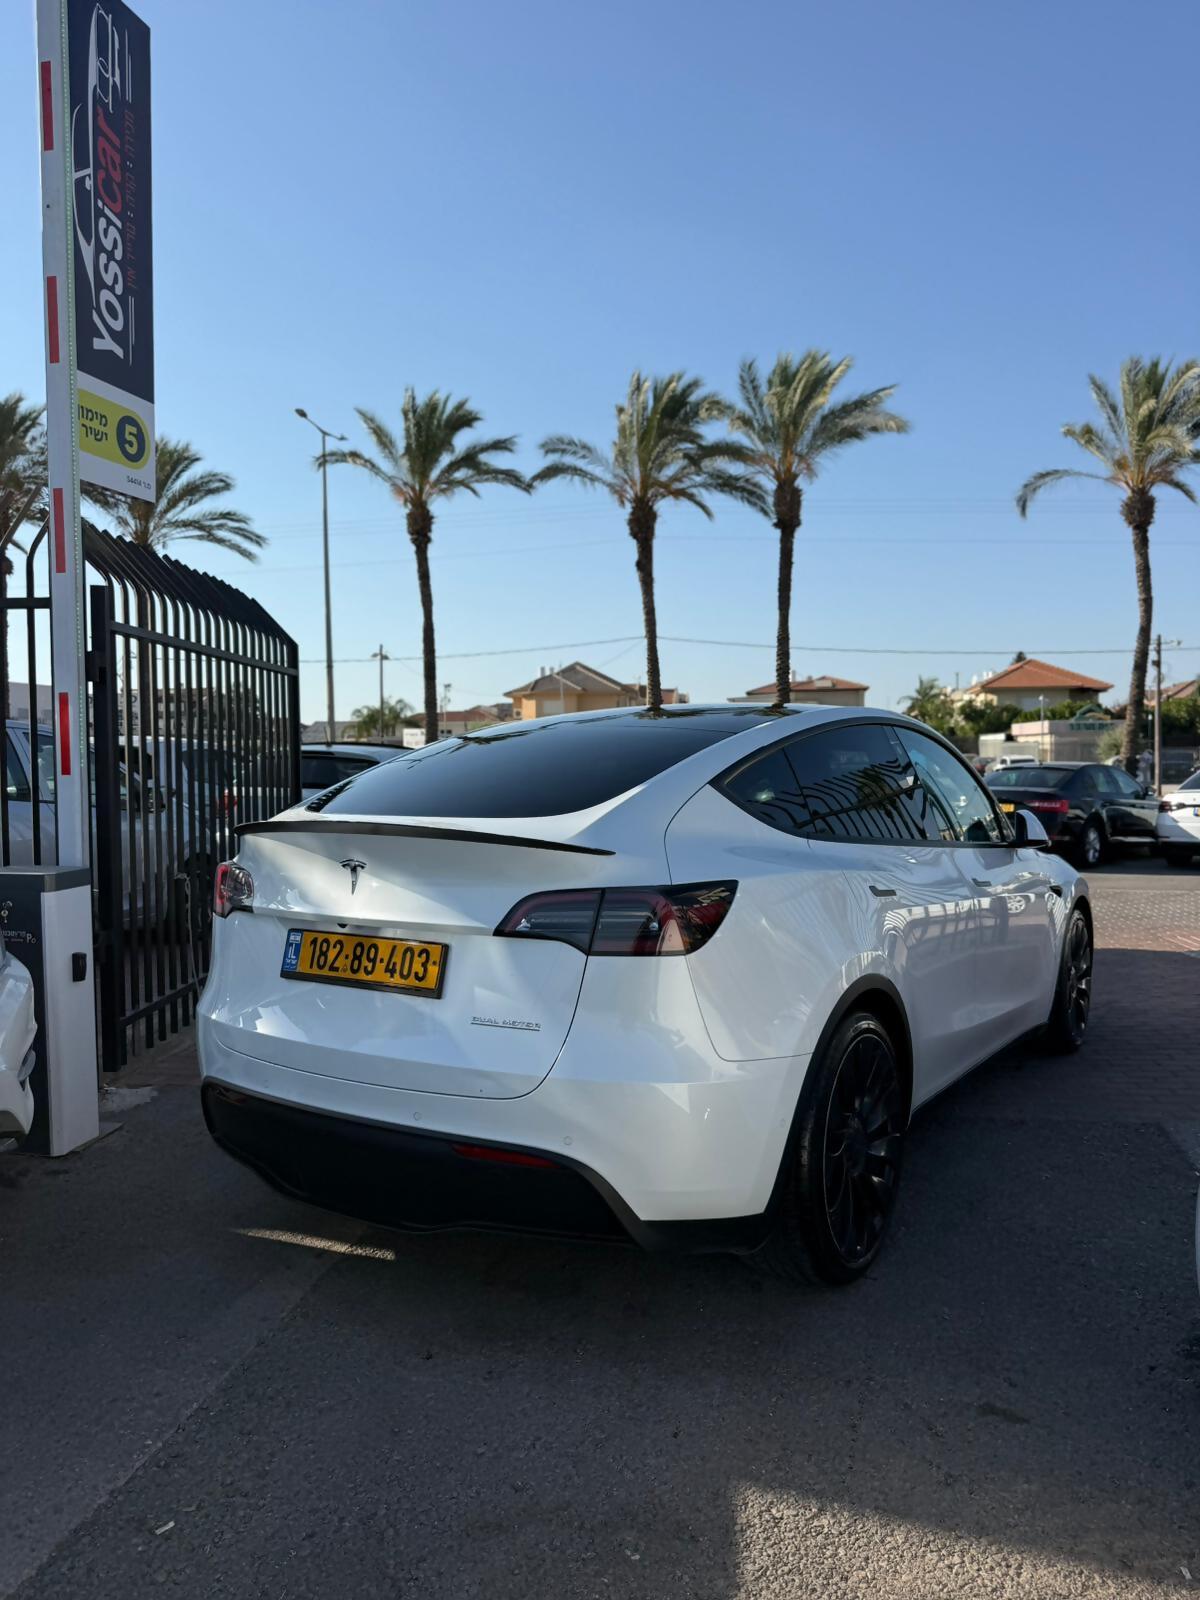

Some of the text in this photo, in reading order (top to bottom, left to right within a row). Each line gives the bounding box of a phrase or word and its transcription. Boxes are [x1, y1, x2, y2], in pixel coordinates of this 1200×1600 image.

[81, 423, 108, 442] ישיר
[124, 423, 138, 455] 5
[472, 1016, 499, 1025] DUAL
